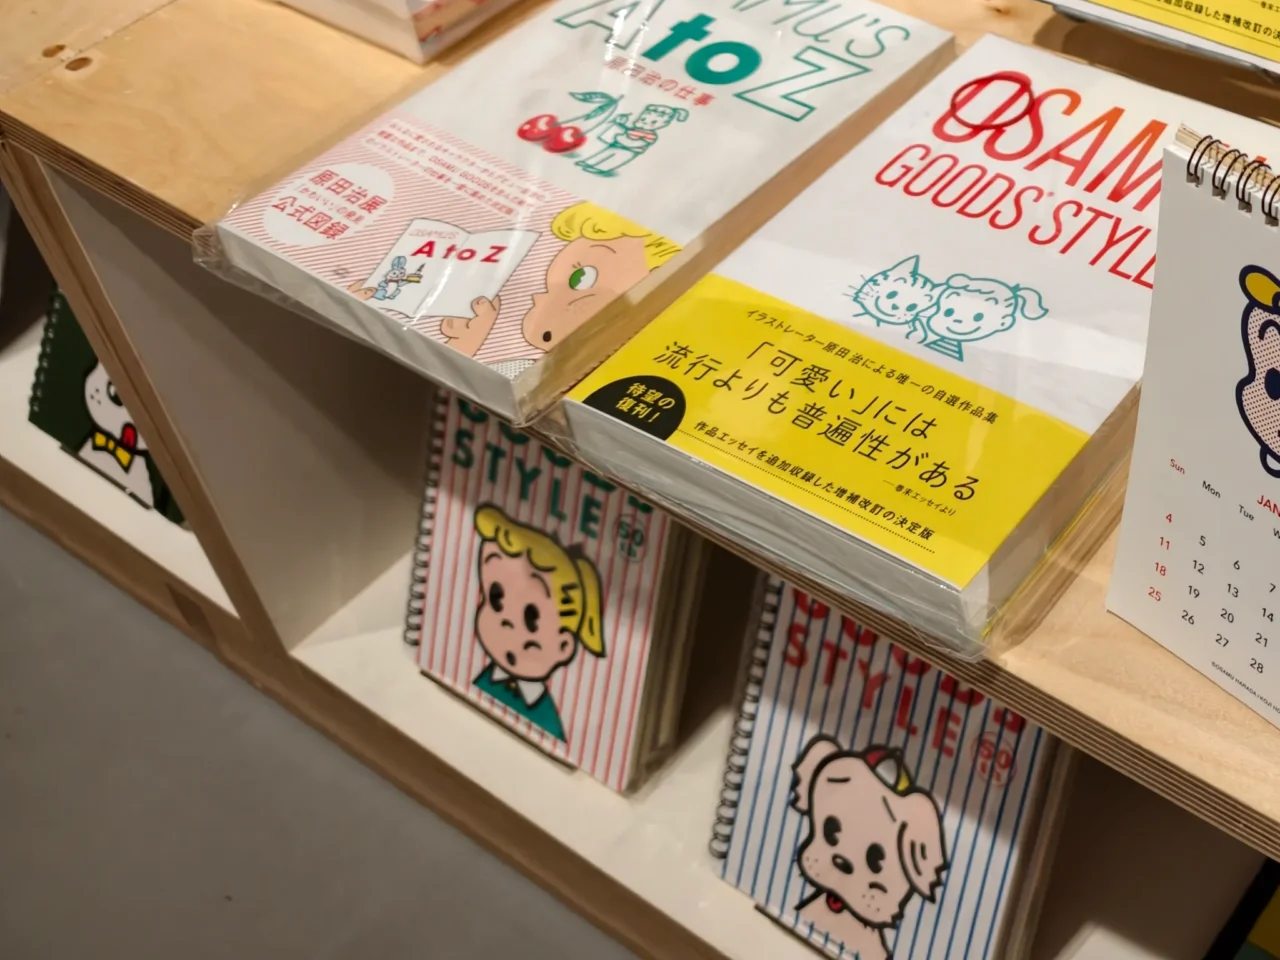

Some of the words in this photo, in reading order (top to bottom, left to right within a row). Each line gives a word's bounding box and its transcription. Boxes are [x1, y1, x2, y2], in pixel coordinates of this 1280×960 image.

[641, 13, 762, 85] to
[734, 46, 872, 122] Z
[271, 195, 350, 240] 公式図録
[308, 169, 388, 214] 原田治展
[875, 144, 1044, 230] GOODS
[410, 240, 436, 258] A
[442, 244, 477, 261] to
[480, 245, 508, 263] Z
[624, 381, 676, 410] 待望の
[653, 341, 979, 502] 流行よりも普遍性がある
[746, 341, 938, 440] 「可愛い」には
[452, 427, 602, 539] STYLE
[693, 420, 937, 542] 作品エッセイを追加収録した増補改訂の決定版
[1169, 459, 1185, 475] Sun
[1202, 480, 1221, 498] Mon
[1238, 504, 1255, 521] Tue
[1159, 537, 1170, 550] 11
[1192, 560, 1204, 574] 12
[1226, 584, 1239, 597] 13
[1261, 608, 1274, 622] 14
[1165, 513, 1172, 523] 4
[1200, 536, 1206, 547] 5
[1233, 560, 1240, 570] 6
[1269, 583, 1276, 593] 7
[1148, 587, 1161, 601] 25
[1181, 610, 1194, 624] 26
[1216, 634, 1229, 647] 27
[1250, 658, 1264, 673] 28
[1154, 563, 1166, 576] 18
[1187, 586, 1200, 599] 19
[1220, 609, 1234, 623] 20
[1255, 633, 1268, 647] 21
[783, 621, 961, 758] STYLE
